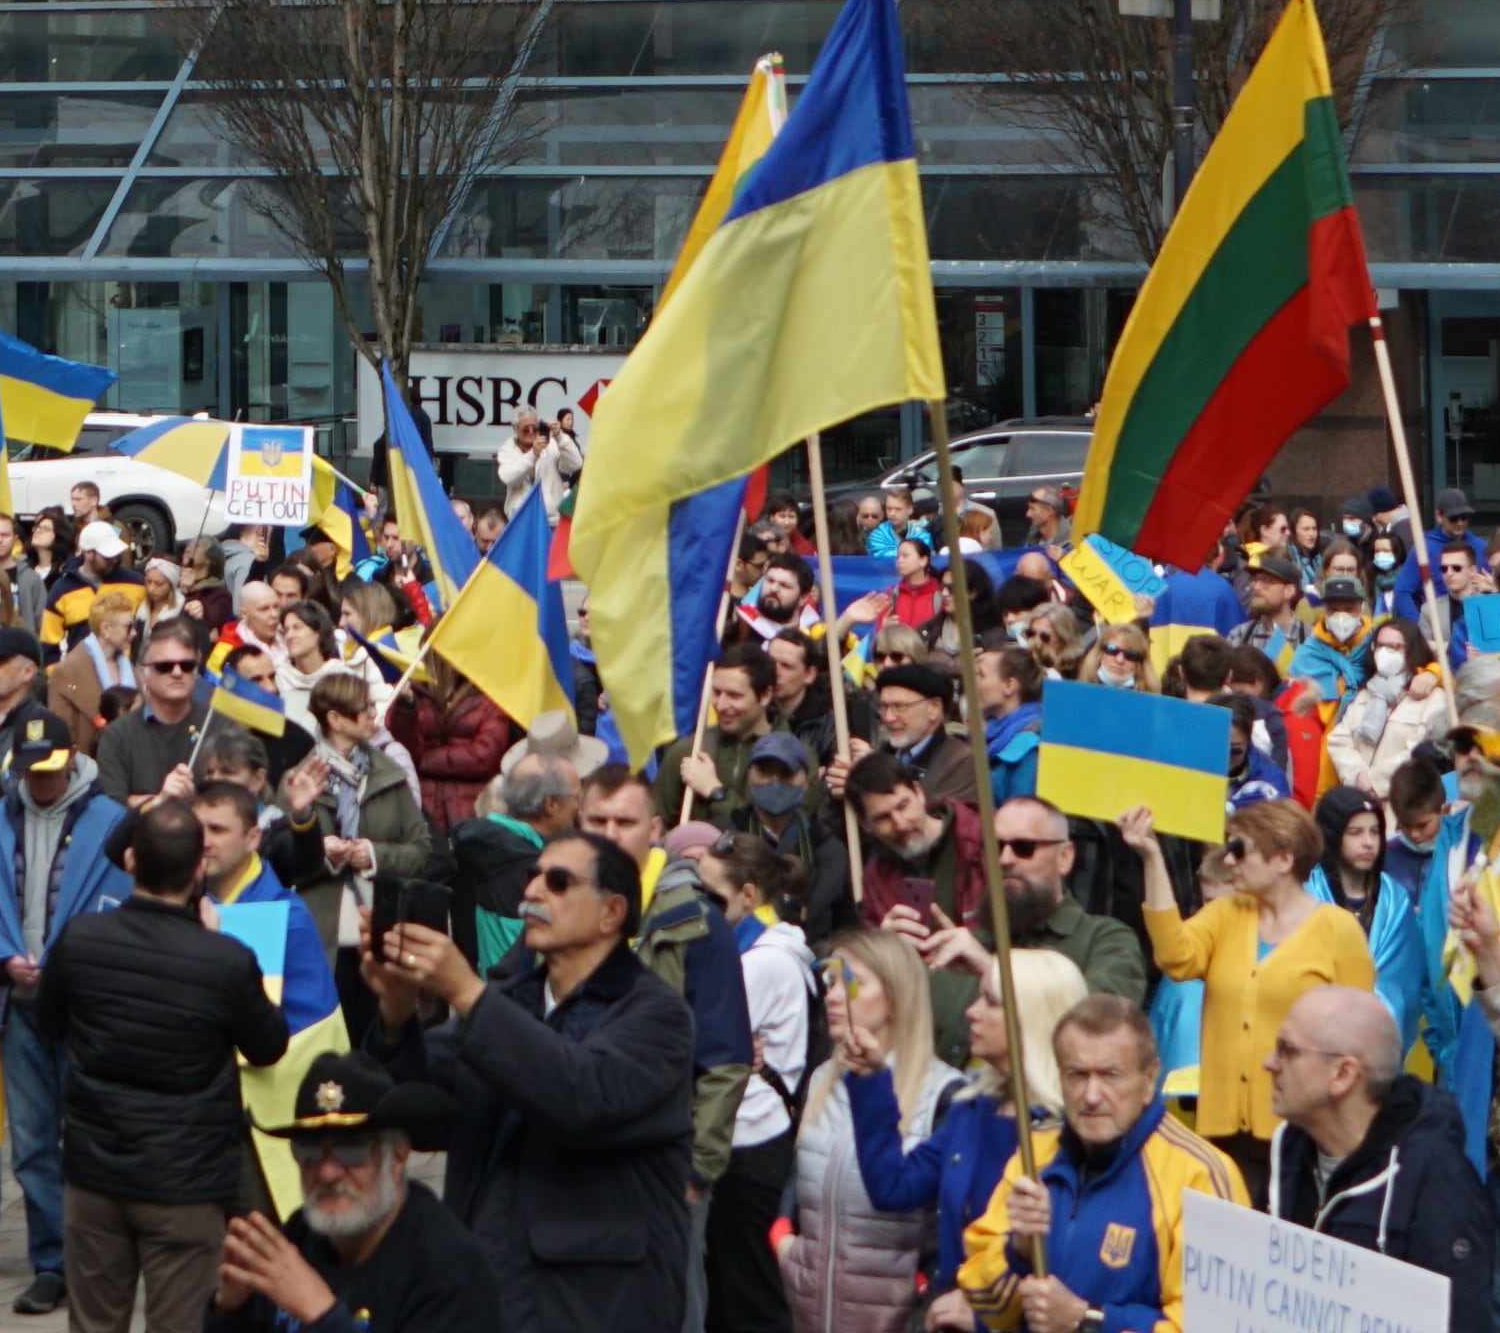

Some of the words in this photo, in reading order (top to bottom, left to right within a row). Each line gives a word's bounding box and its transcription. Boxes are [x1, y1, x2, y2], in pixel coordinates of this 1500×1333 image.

[978, 331, 986, 343] 2
[406, 376, 567, 427] HSBC
[228, 499, 267, 518] GET
[273, 501, 308, 520] OUT
[231, 480, 305, 502] PUTIN
[1099, 540, 1161, 593] STOP
[1268, 1224, 1356, 1287] BIDEN:
[1184, 1244, 1255, 1310] PUTIN
[1263, 1279, 1352, 1333] CANNOT
